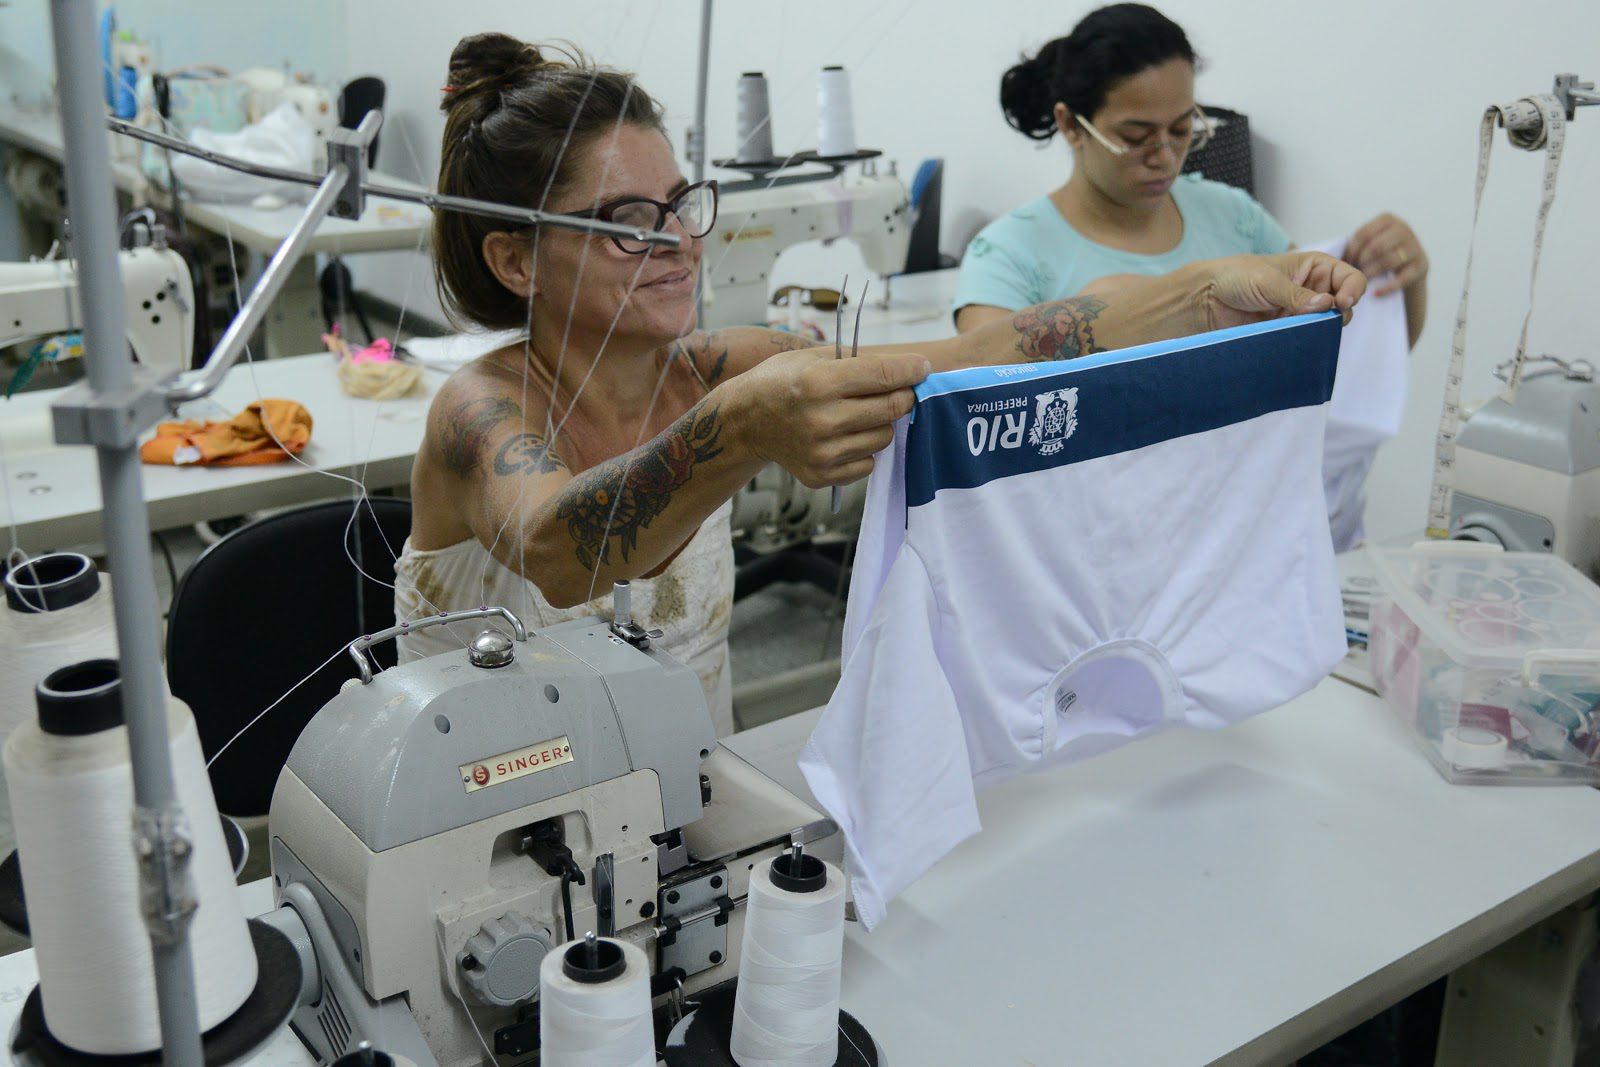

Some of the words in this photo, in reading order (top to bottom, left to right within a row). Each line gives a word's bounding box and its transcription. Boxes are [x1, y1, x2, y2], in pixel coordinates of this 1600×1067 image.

[967, 396, 1028, 413] PREFEITURA
[966, 411, 1027, 457] RIO
[496, 747, 564, 776] SINGER
